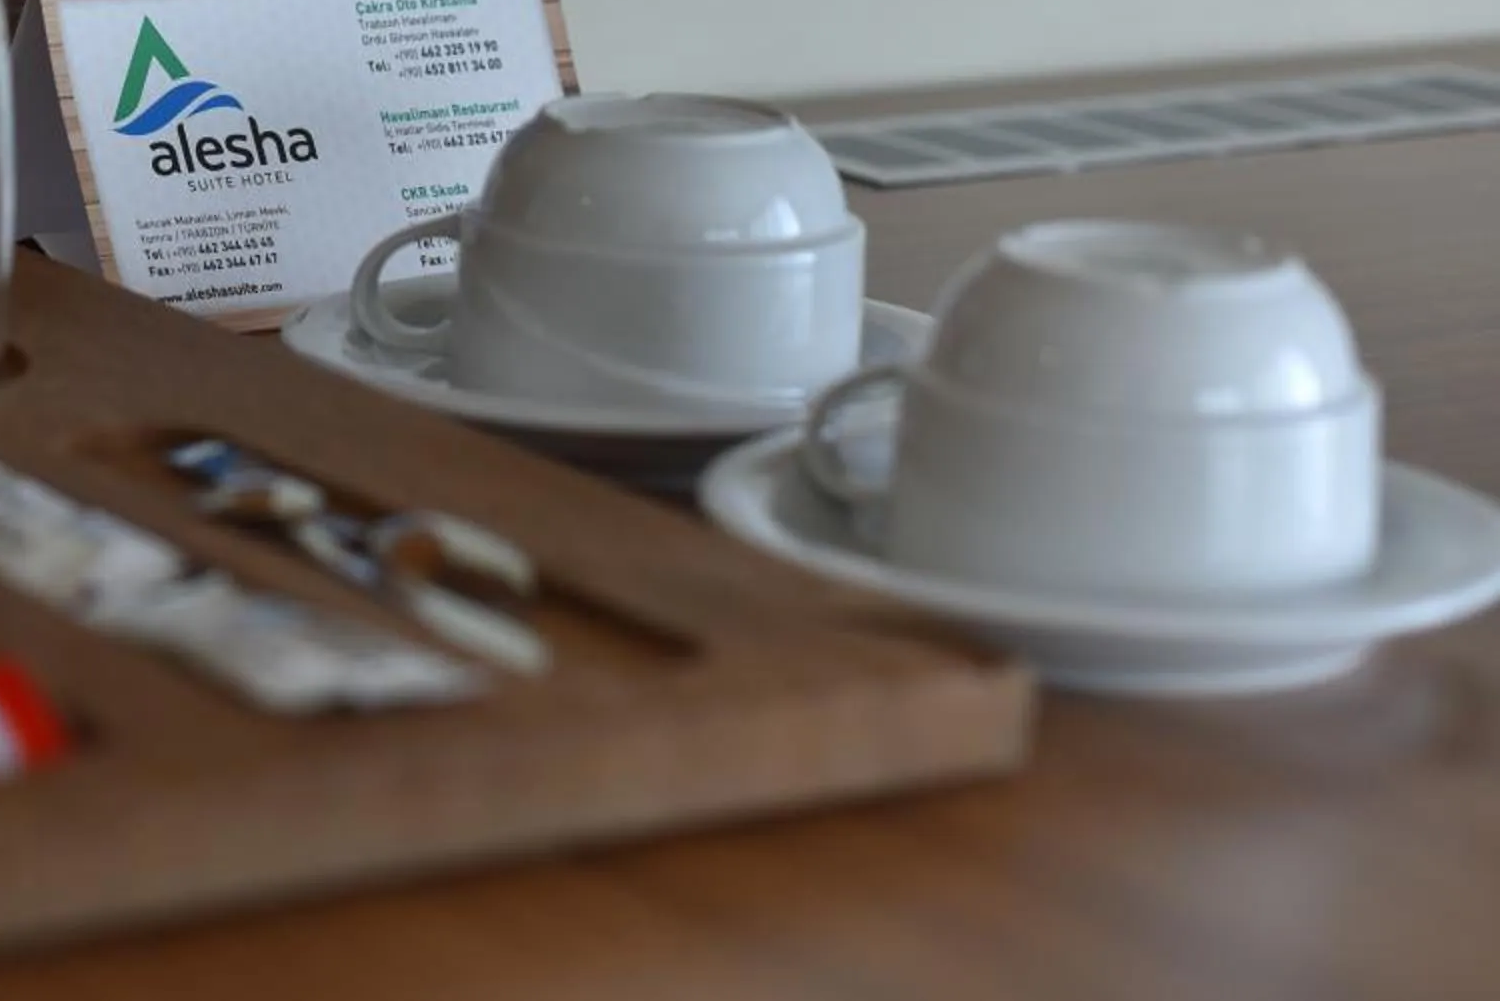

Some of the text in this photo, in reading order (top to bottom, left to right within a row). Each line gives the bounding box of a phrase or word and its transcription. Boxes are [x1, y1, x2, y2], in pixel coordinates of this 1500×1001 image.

[358, 17, 399, 30] Trabzon
[362, 33, 387, 46] Ordu
[421, 45, 441, 58] 462
[444, 43, 465, 56] 325
[468, 41, 481, 53] 19
[484, 39, 499, 52] 90
[367, 59, 391, 73] Tel:
[425, 63, 445, 76] 452
[471, 59, 486, 72] 34
[488, 57, 503, 70] 00
[451, 99, 520, 116] Restaurant
[149, 115, 318, 176] alesha
[444, 135, 464, 147] 462
[466, 133, 488, 146] 325
[187, 170, 293, 193] SUITE HOTEL
[401, 183, 469, 201] CKR Skoda
[181, 226, 230, 240] TRABZON
[198, 242, 219, 255] 462
[221, 239, 242, 252] 344
[203, 259, 224, 271] 462
